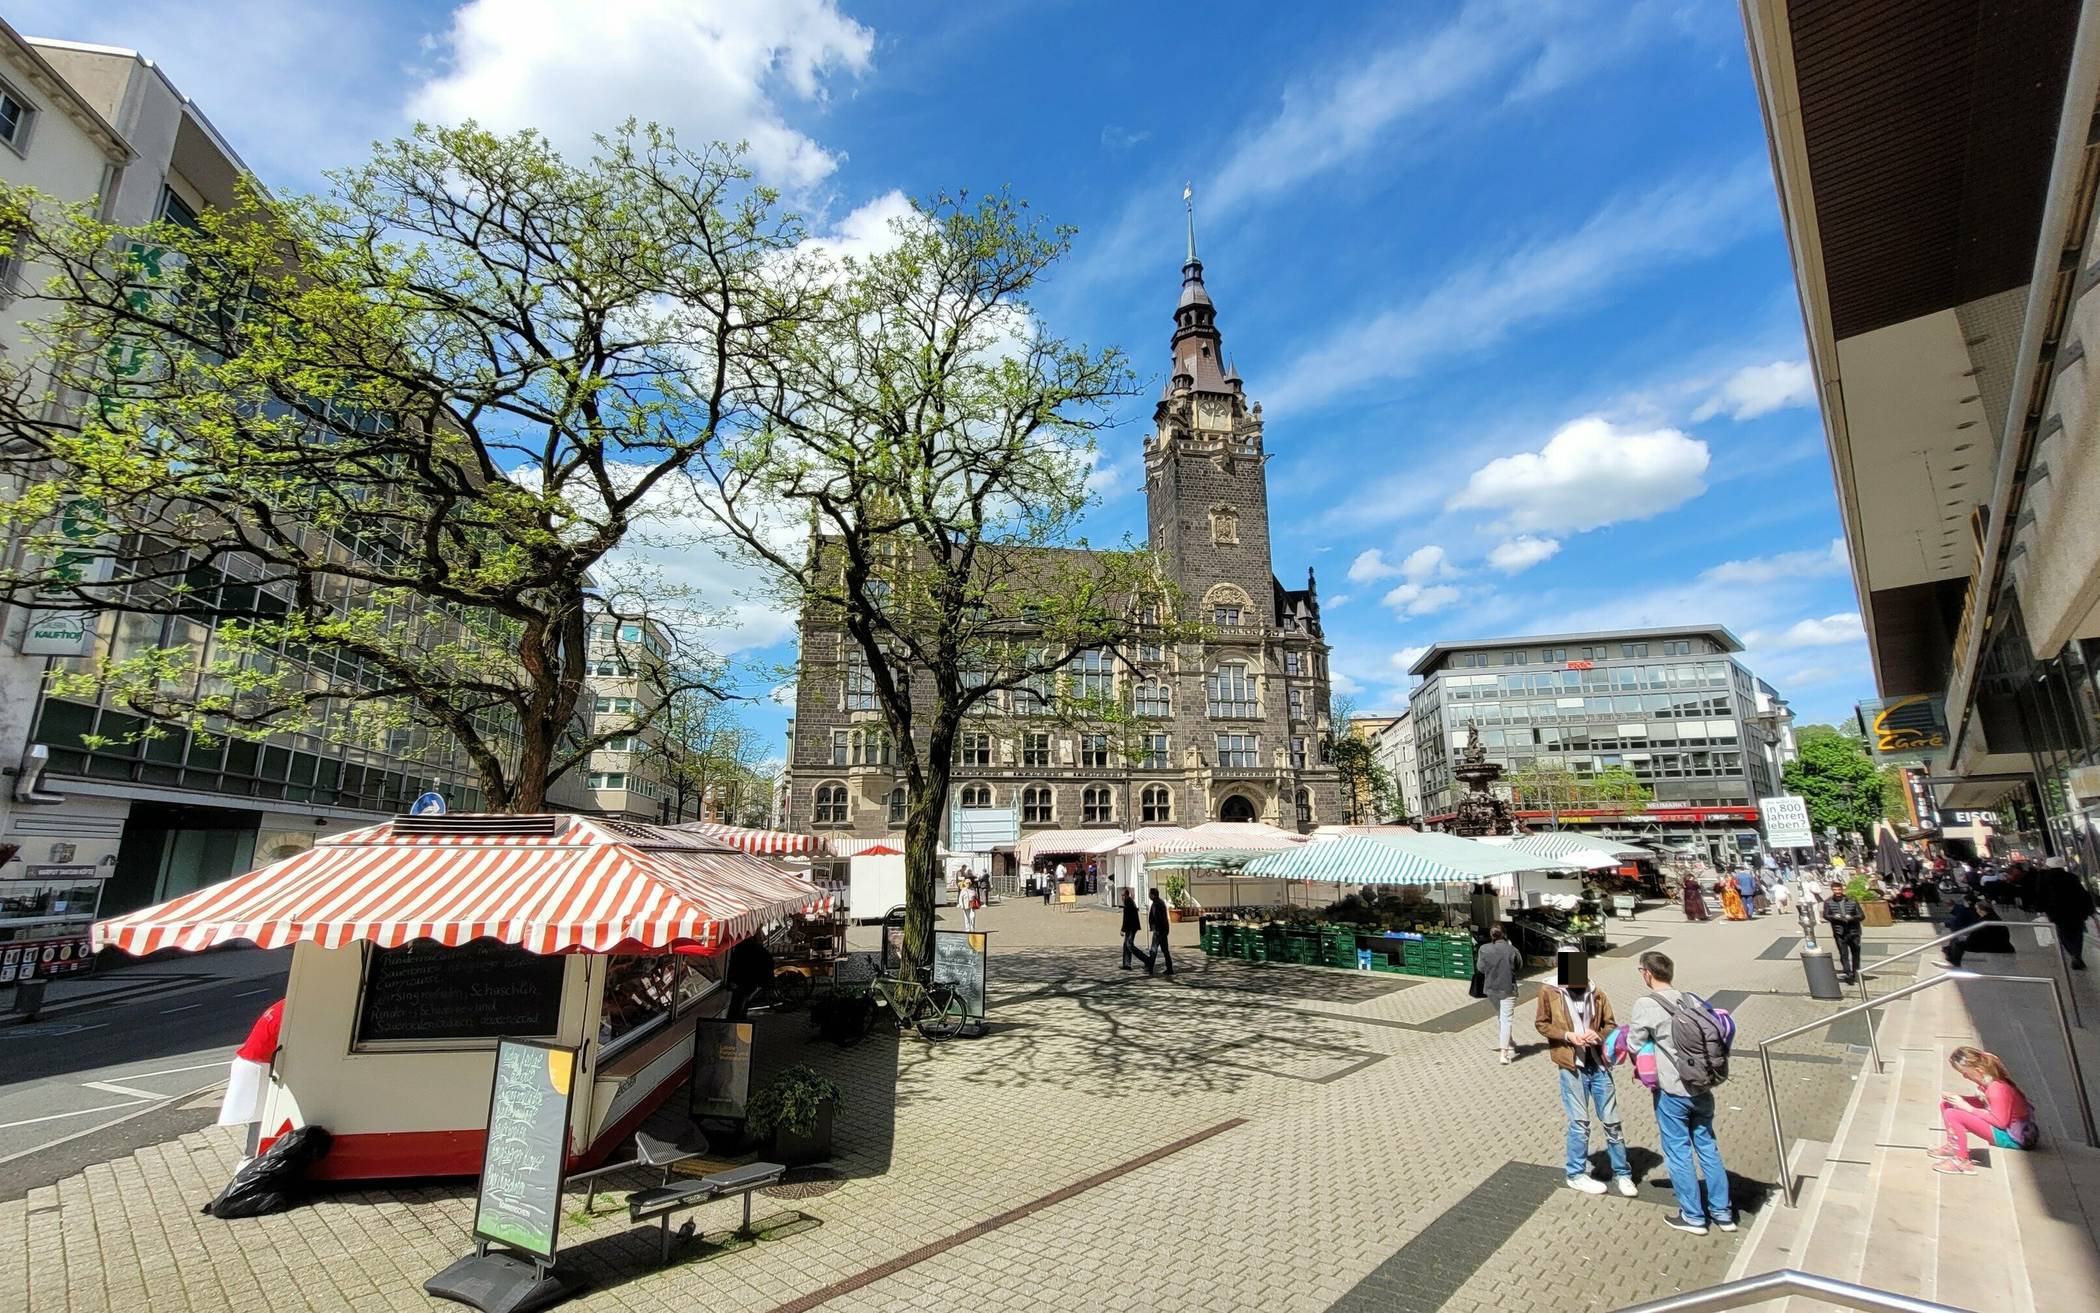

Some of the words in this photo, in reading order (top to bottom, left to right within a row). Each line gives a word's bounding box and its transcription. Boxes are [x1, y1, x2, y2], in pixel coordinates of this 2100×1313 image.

[1766, 806, 1777, 814] in
[1779, 803, 1801, 812] 800
[1767, 811, 1805, 821] Jahren
[1767, 819, 1806, 830] leben?
